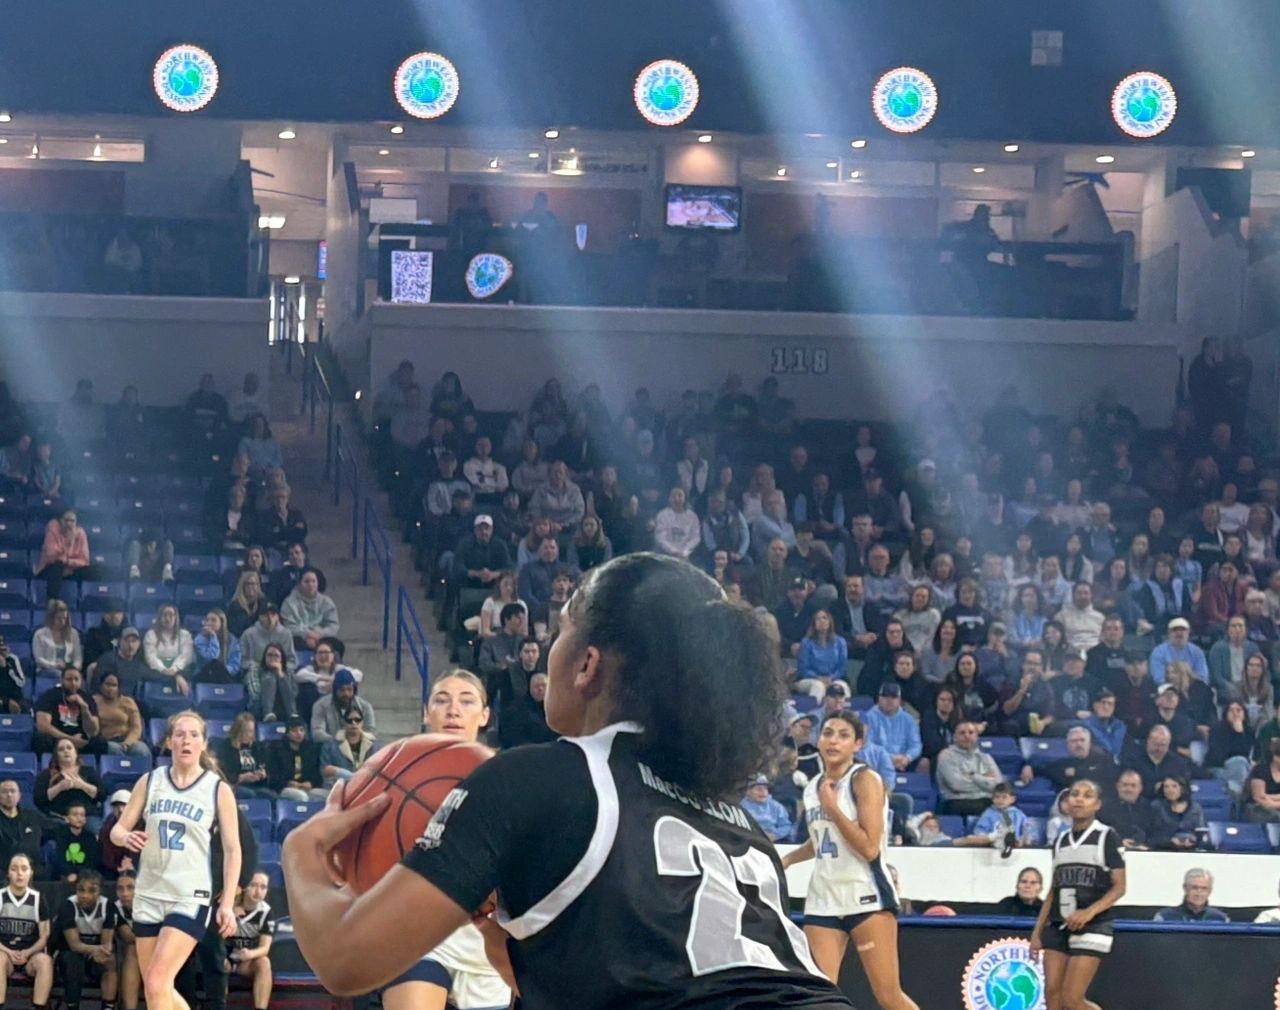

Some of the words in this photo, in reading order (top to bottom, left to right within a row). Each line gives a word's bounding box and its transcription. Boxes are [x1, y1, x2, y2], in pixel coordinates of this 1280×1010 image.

[771, 346, 829, 374] 118
[149, 799, 205, 823] MEDFIELD
[158, 820, 187, 851] 12
[1059, 888, 1078, 919] 5
